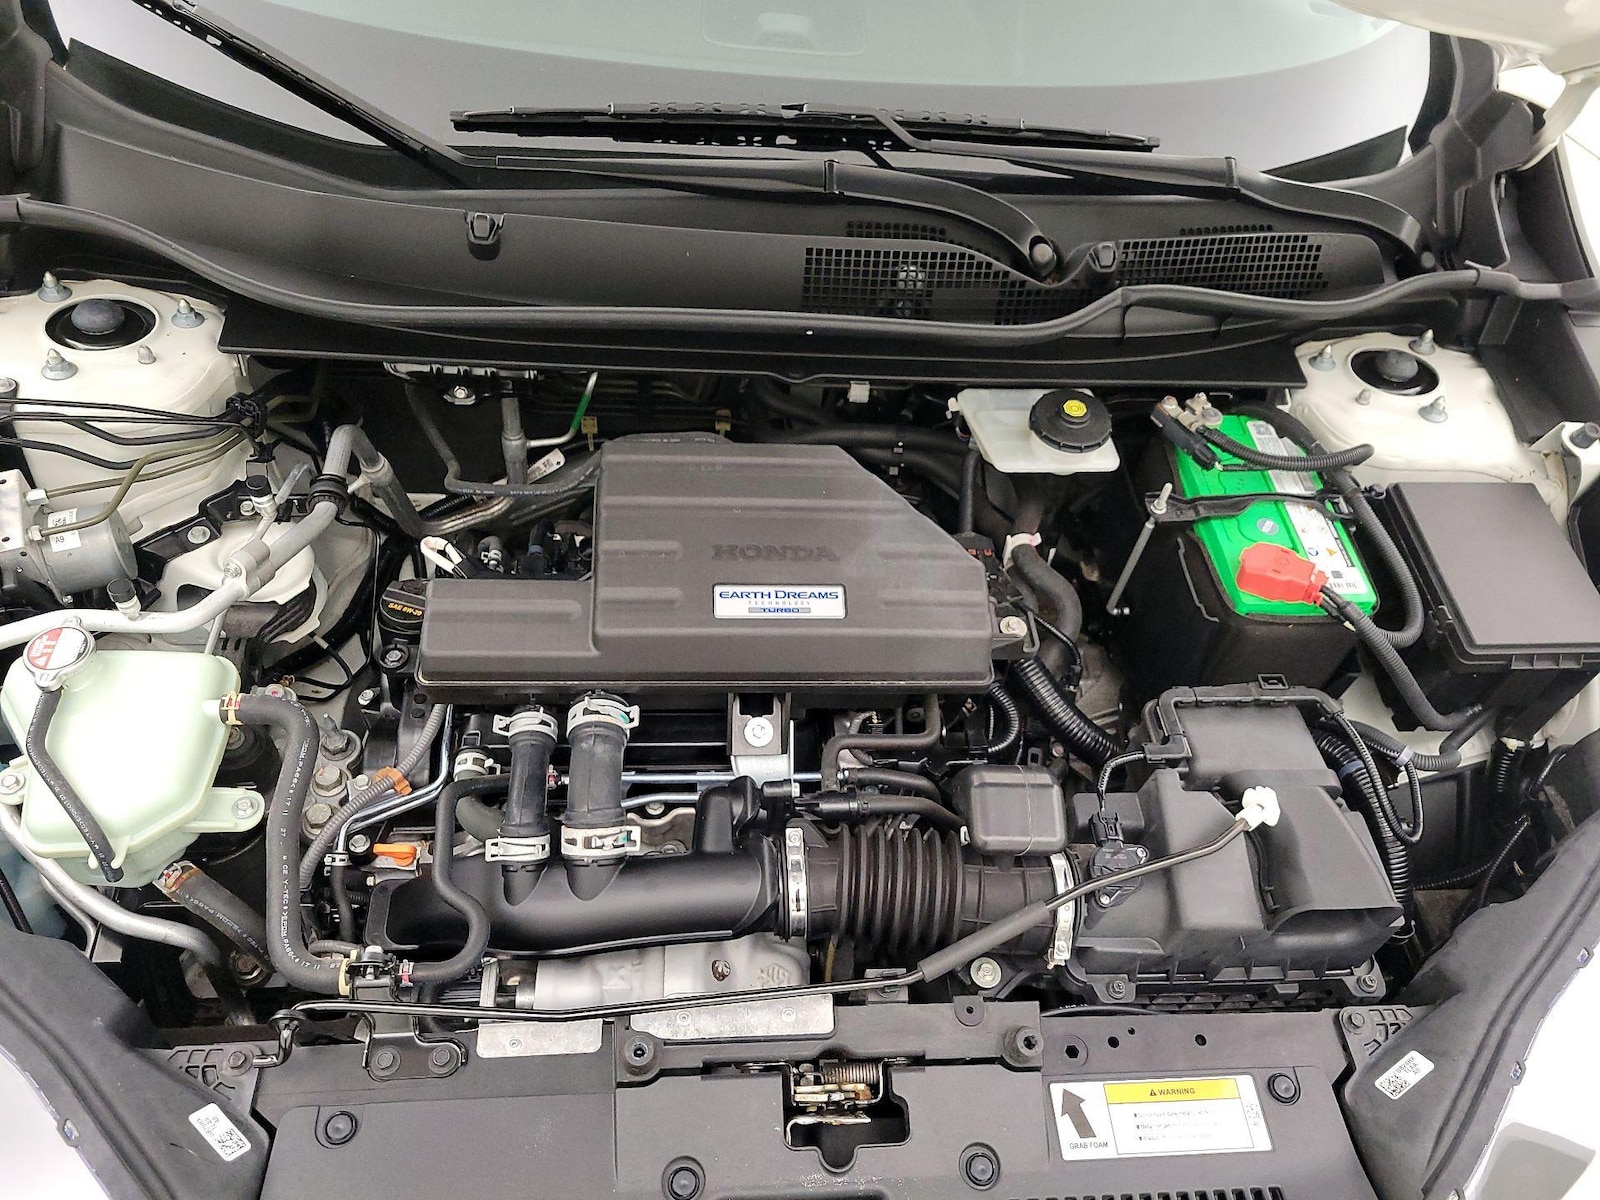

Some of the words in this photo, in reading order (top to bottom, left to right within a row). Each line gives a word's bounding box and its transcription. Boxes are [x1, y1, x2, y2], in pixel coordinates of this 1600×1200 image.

[55, 535, 65, 544] A9
[711, 544, 840, 560] HONDA
[719, 591, 771, 599] EARTH
[774, 590, 839, 599] DREAMS
[387, 602, 403, 611] SAE
[402, 606, 423, 617] 0W-20
[1158, 1087, 1196, 1096] WARNING
[1069, 1142, 1089, 1150] GRAB
[1089, 1141, 1109, 1149] FOAM
